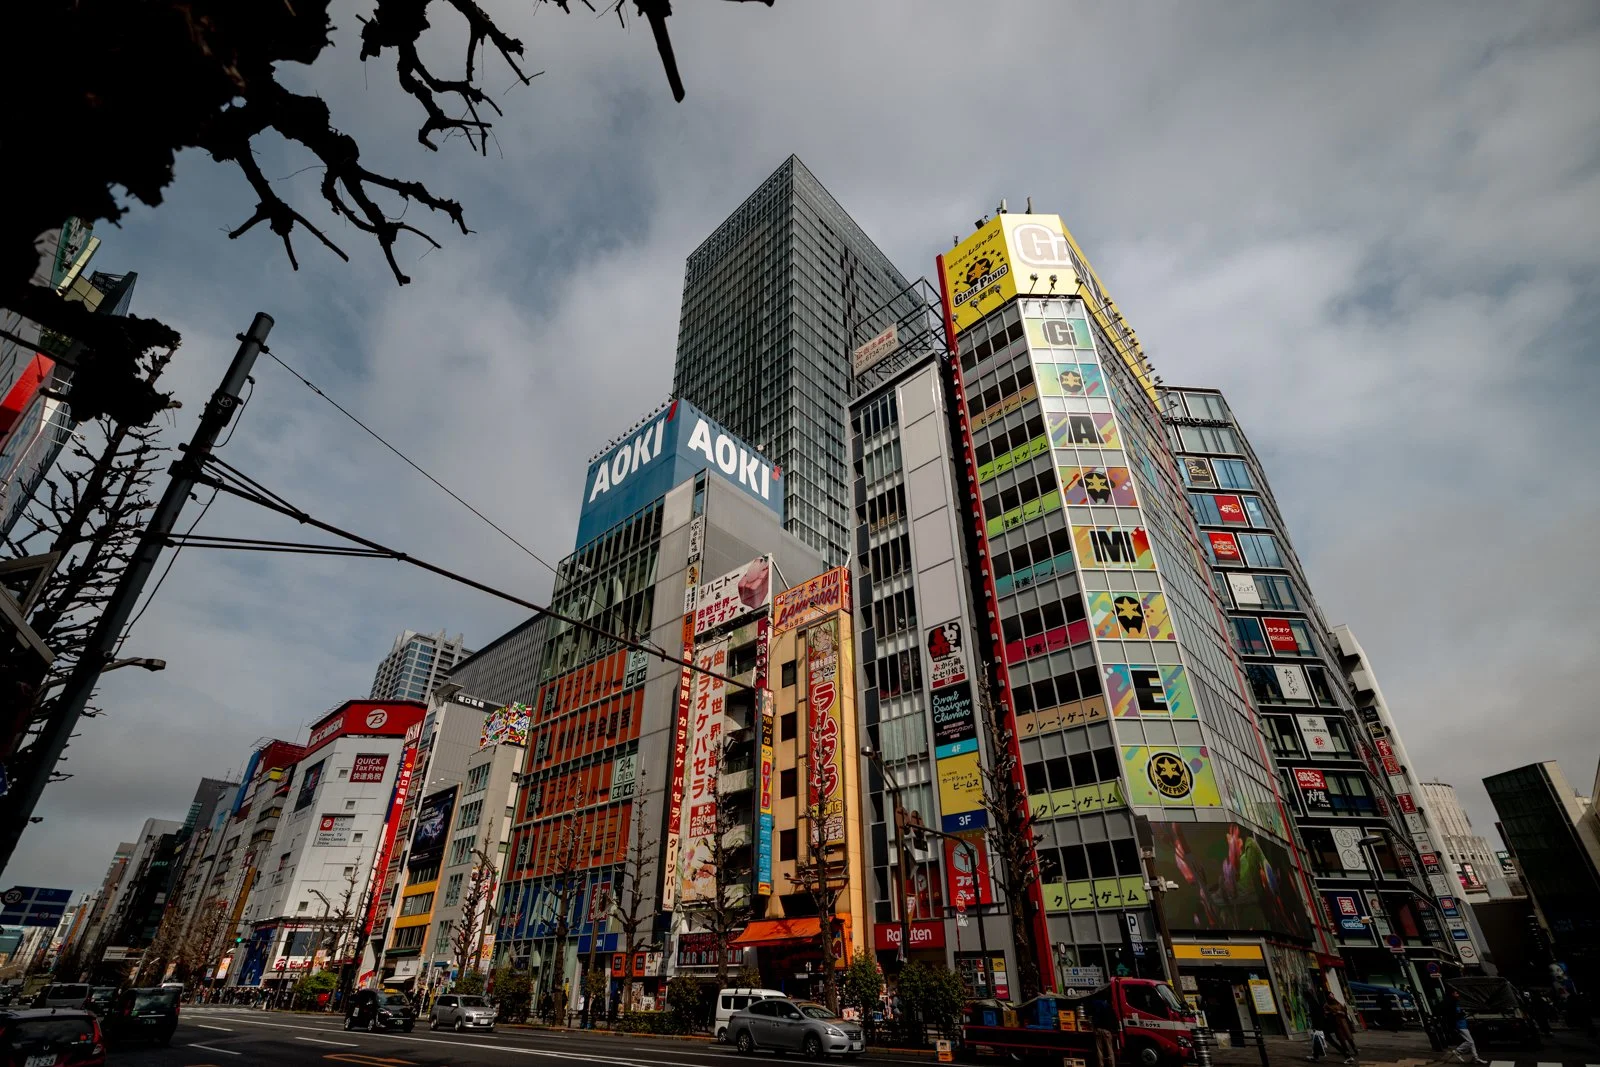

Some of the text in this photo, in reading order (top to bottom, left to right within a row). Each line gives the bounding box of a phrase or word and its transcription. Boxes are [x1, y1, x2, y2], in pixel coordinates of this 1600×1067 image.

[955, 265, 1007, 305] GAME PANIC
[589, 418, 665, 504] AOKI
[687, 418, 770, 500] AOKI
[981, 442, 1048, 478] アーケードゲーム
[822, 571, 838, 589] DVD
[697, 605, 738, 633] カラオケ
[1026, 708, 1099, 733] クレーンゲーム
[952, 744, 961, 753] 4F
[761, 762, 770, 808] DVD
[954, 779, 979, 791] ビームス
[1039, 794, 1117, 816] クレーンゲーム
[959, 815, 972, 826] 3F
[665, 838, 677, 900] ダーツバー
[7, 892, 21, 901] 50
[1054, 890, 1139, 908] クレーンゲーム
[1128, 916, 1136, 932] P
[679, 950, 742, 964] BAR RHYHM
